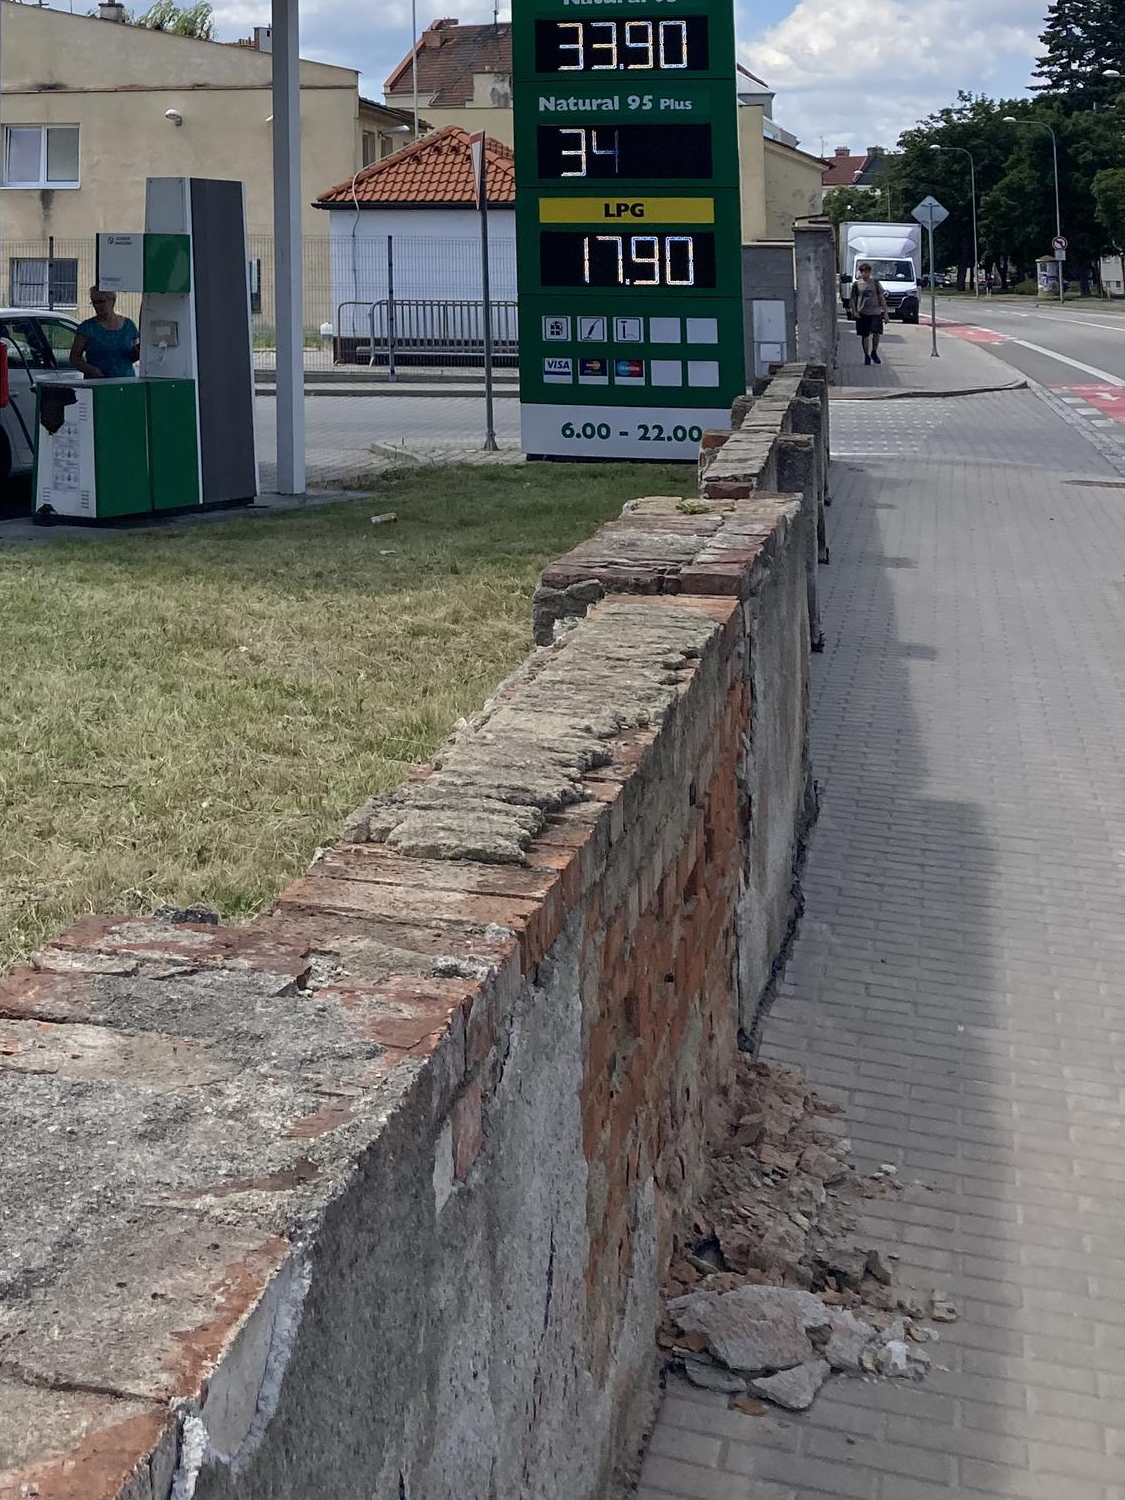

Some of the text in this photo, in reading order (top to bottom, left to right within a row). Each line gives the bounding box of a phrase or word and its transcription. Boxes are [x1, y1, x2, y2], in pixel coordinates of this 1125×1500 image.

[557, 19, 687, 71] 33.90
[538, 95, 693, 111] Natural 95 Plus
[603, 202, 645, 219] LPG
[583, 235, 695, 286] 17.90
[547, 360, 570, 369] VISA
[561, 422, 611, 440] 6.00
[636, 424, 703, 443] 22.00
